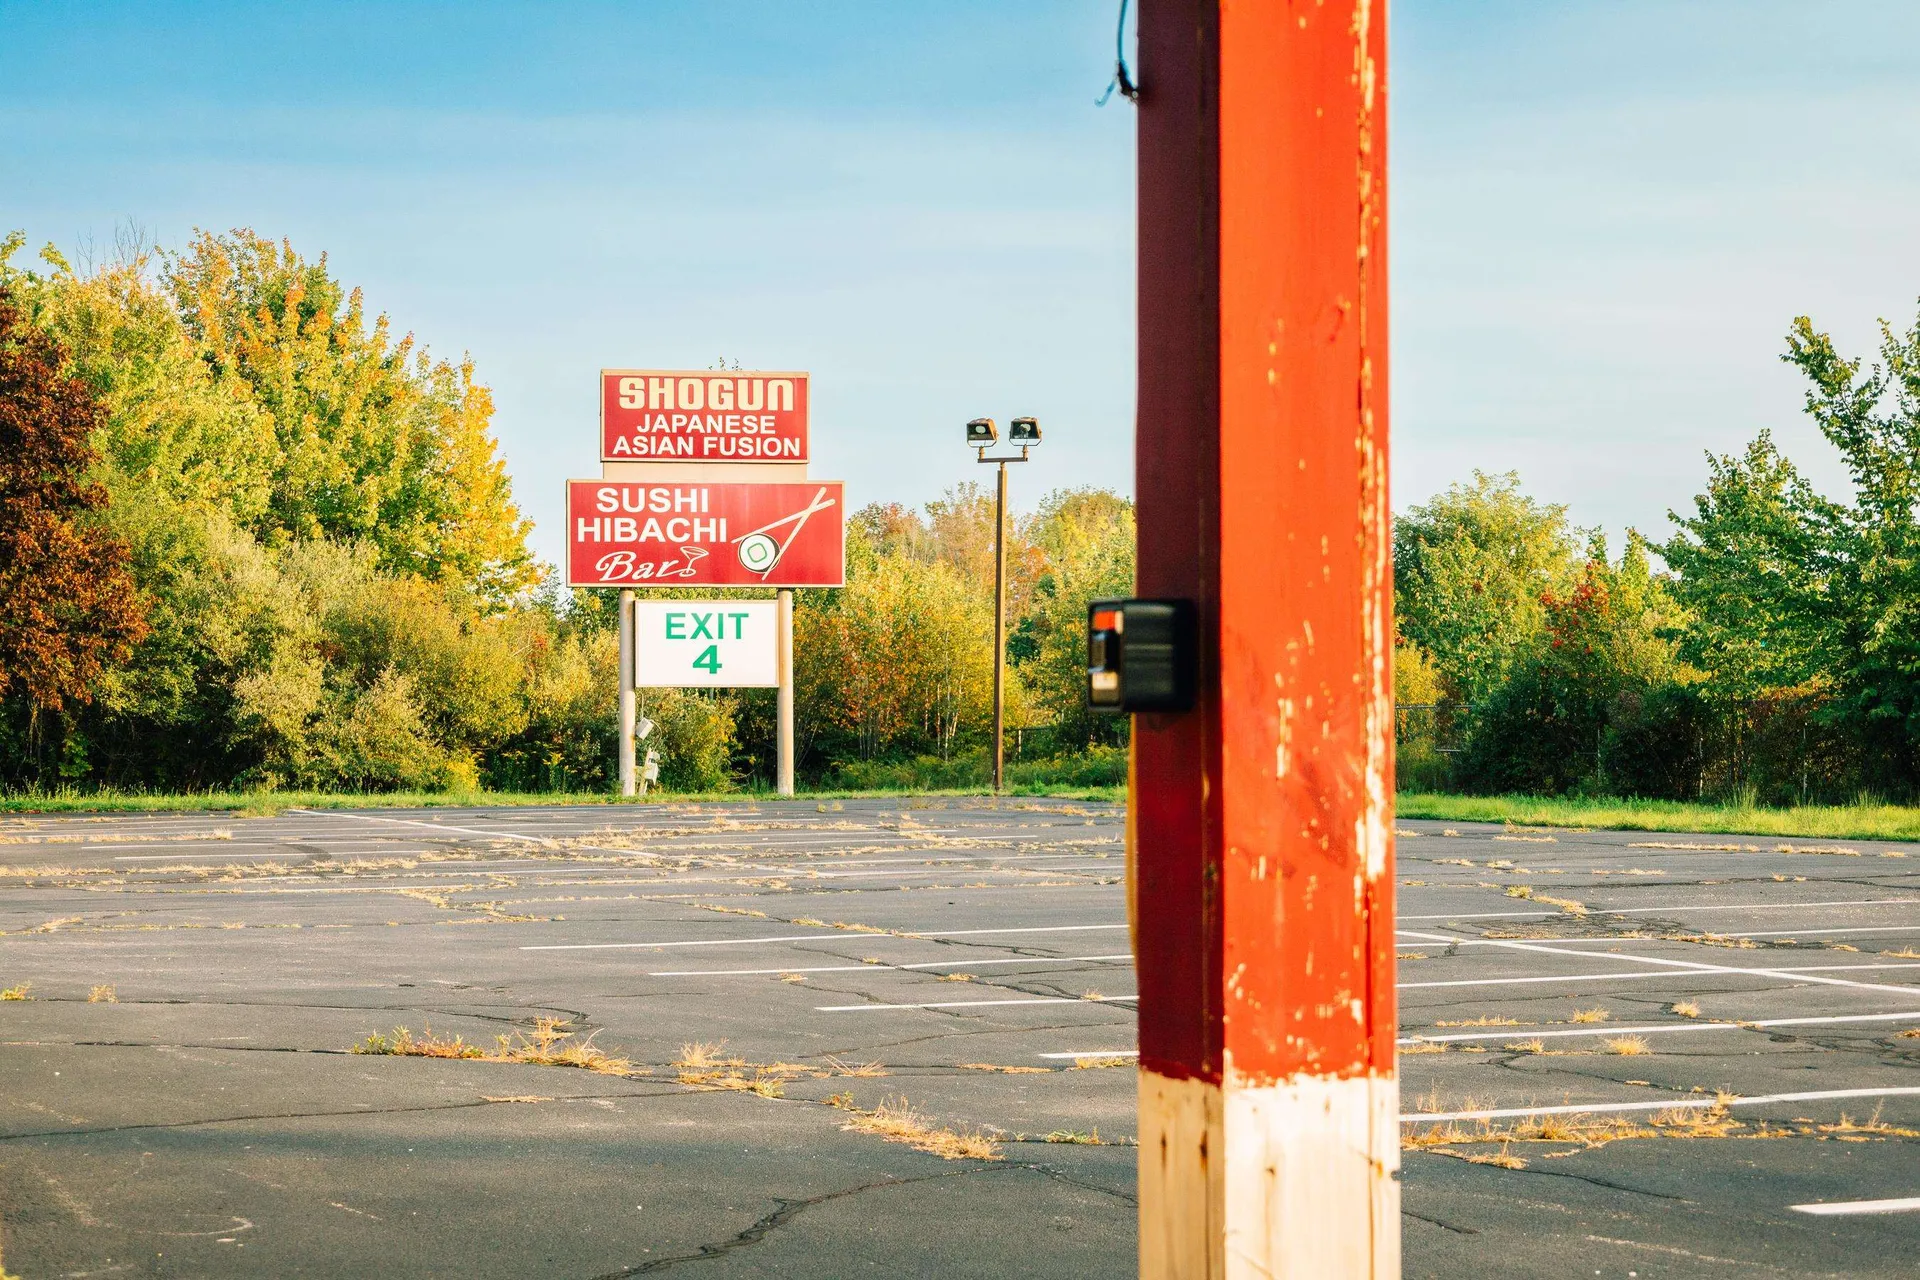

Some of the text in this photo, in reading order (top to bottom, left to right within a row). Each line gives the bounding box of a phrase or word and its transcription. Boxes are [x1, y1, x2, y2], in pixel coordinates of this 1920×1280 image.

[619, 377, 794, 411] SHOGUN
[637, 414, 776, 434] JAPANESE
[612, 436, 800, 456] ASIAN FUSION
[596, 488, 709, 513] SUSHI
[577, 517, 727, 543] HIBACHI
[595, 551, 681, 581] Bar
[666, 613, 749, 639] EXIT
[692, 645, 723, 674] 4
